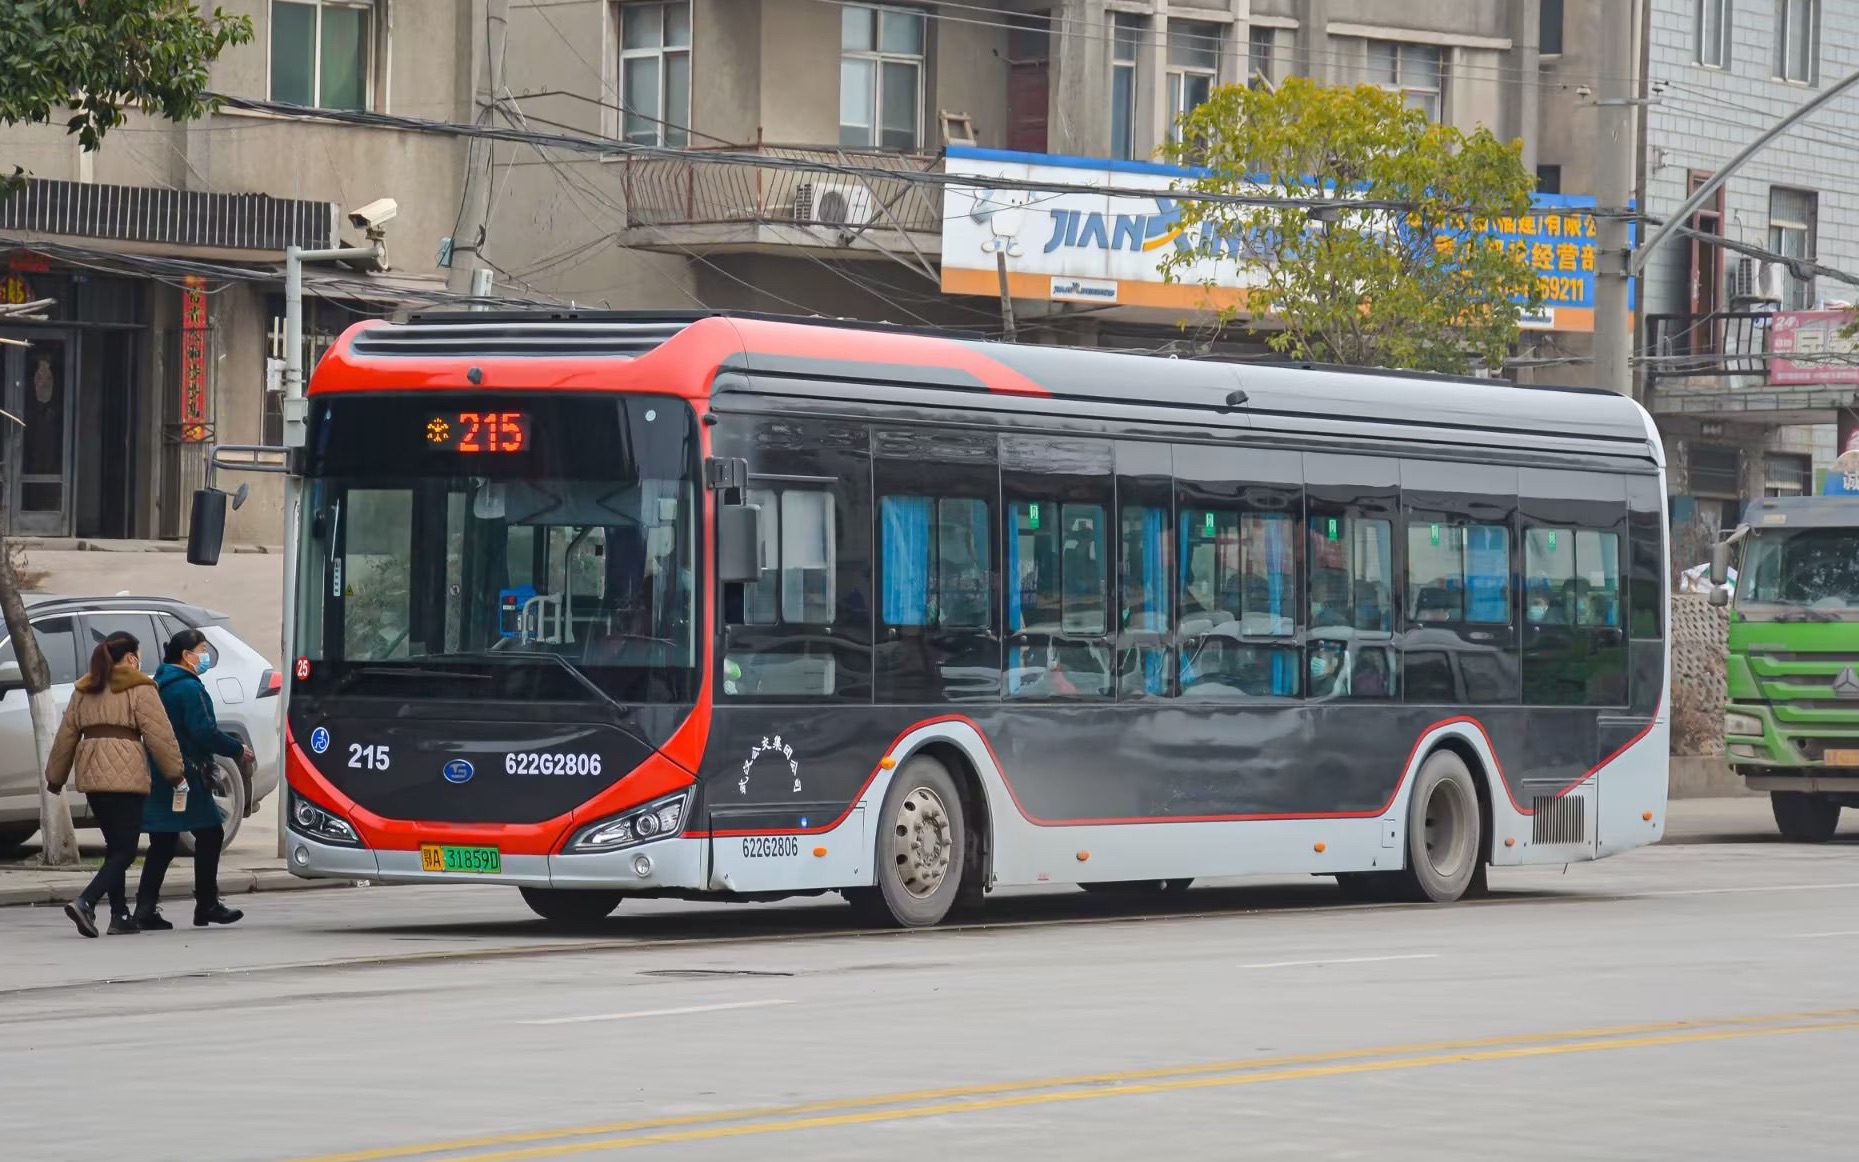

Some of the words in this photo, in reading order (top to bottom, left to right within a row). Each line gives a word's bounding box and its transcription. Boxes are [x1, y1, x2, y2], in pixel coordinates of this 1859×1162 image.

[460, 413, 522, 452] 215
[297, 660, 308, 677] 25
[348, 743, 390, 771] 215
[505, 753, 602, 776] 622G2806
[742, 836, 798, 858] 622G2806
